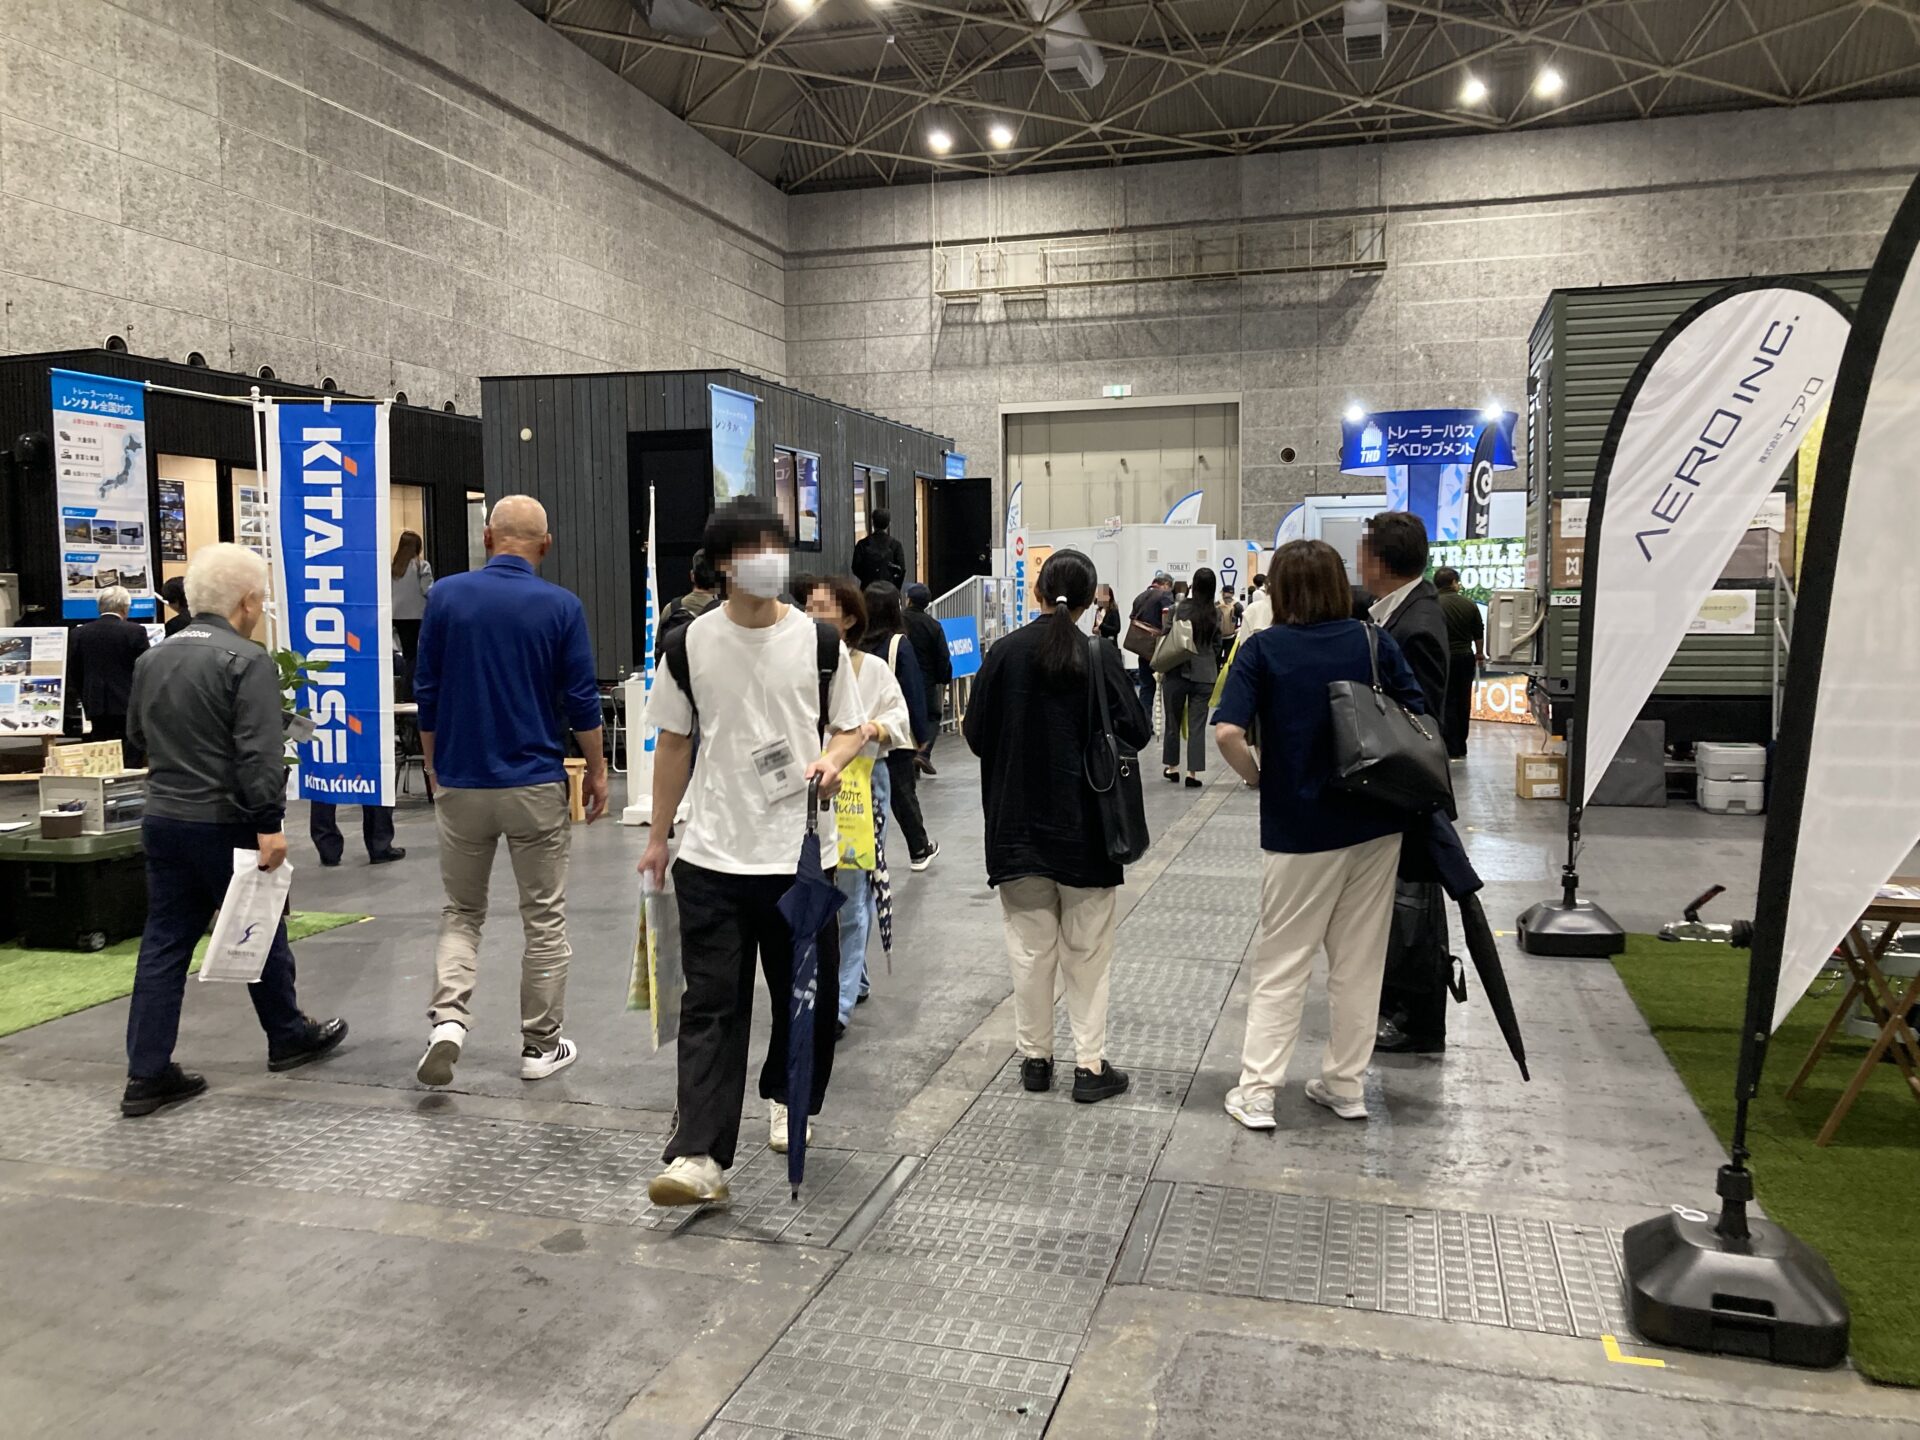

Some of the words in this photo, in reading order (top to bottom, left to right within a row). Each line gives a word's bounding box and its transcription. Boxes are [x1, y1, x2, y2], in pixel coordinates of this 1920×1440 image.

[1732, 315, 1801, 404] INC.
[62, 396, 134, 415] レンタル全国対応
[1387, 424, 1475, 440] トレーラーハウス
[1360, 450, 1381, 464] THD
[1387, 442, 1476, 457] デベロップメント
[1458, 567, 1525, 590] OUSE
[1555, 596, 1578, 604] T-06
[1472, 680, 1527, 714] TOE
